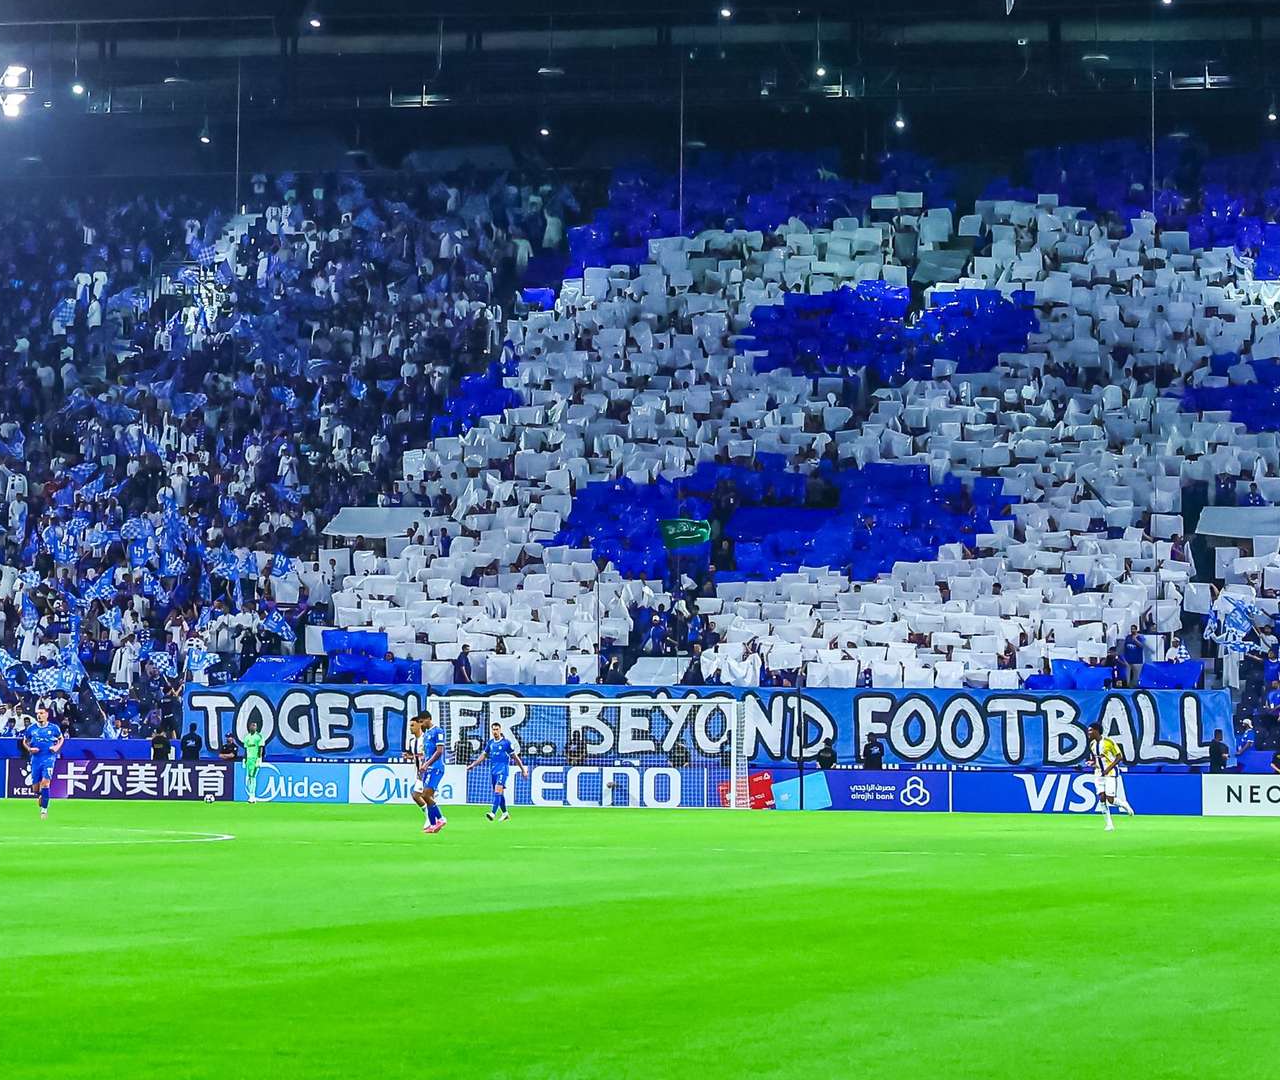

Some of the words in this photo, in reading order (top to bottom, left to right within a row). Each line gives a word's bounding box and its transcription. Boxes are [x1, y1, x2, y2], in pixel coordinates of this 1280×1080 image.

[568, 691, 835, 758] BEYOND
[857, 692, 1212, 761] FOOTBALL
[56, 762, 228, 797] 卡尔美体育
[257, 776, 338, 799] Midea
[376, 778, 453, 800] Mia
